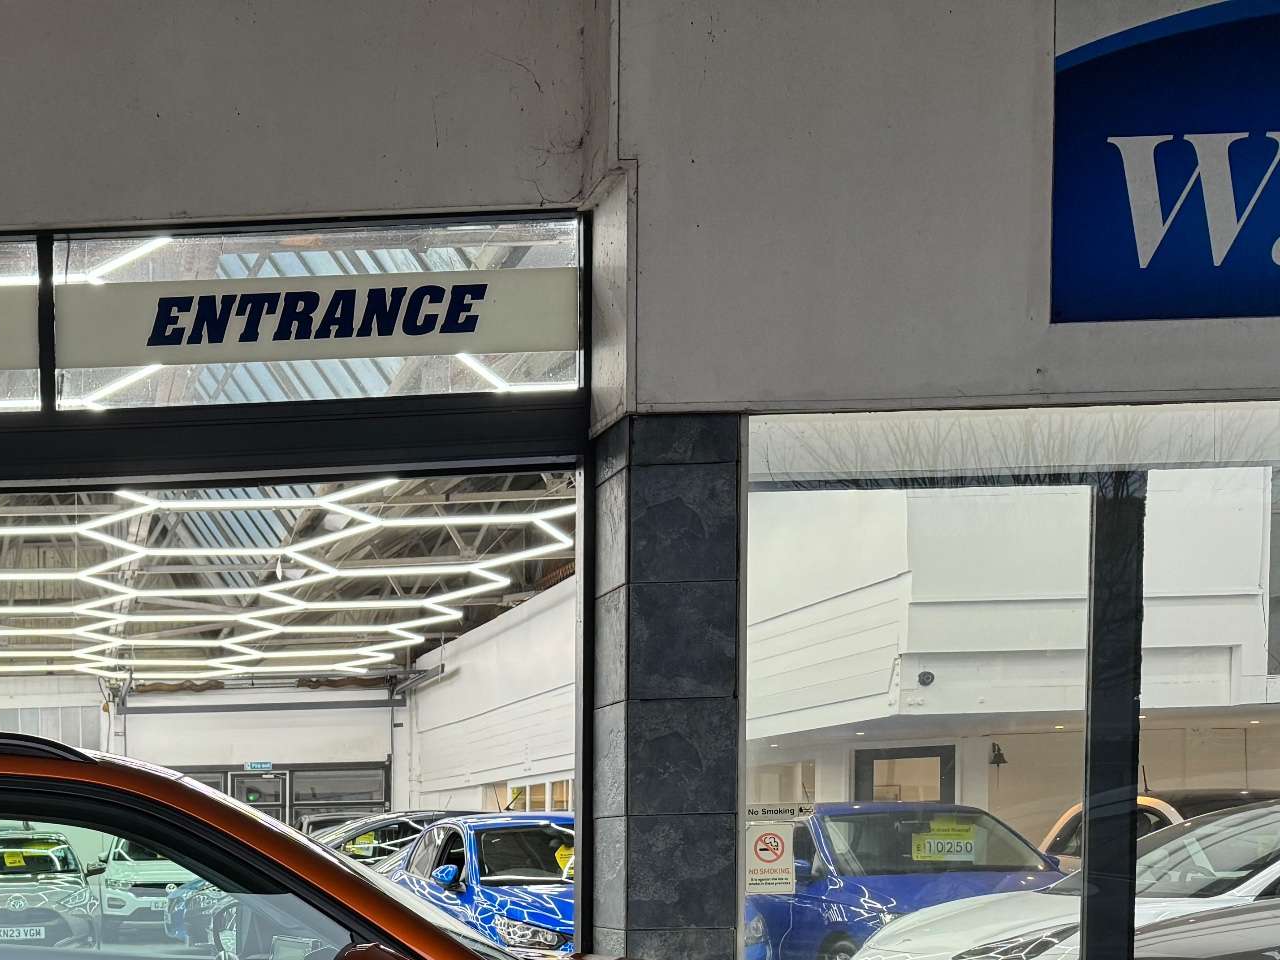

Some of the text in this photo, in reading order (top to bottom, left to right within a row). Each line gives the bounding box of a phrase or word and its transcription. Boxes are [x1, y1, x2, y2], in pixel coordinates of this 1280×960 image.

[146, 283, 488, 347] ENTRANCE
[761, 807, 795, 816] Smoking
[926, 841, 973, 854] 10250
